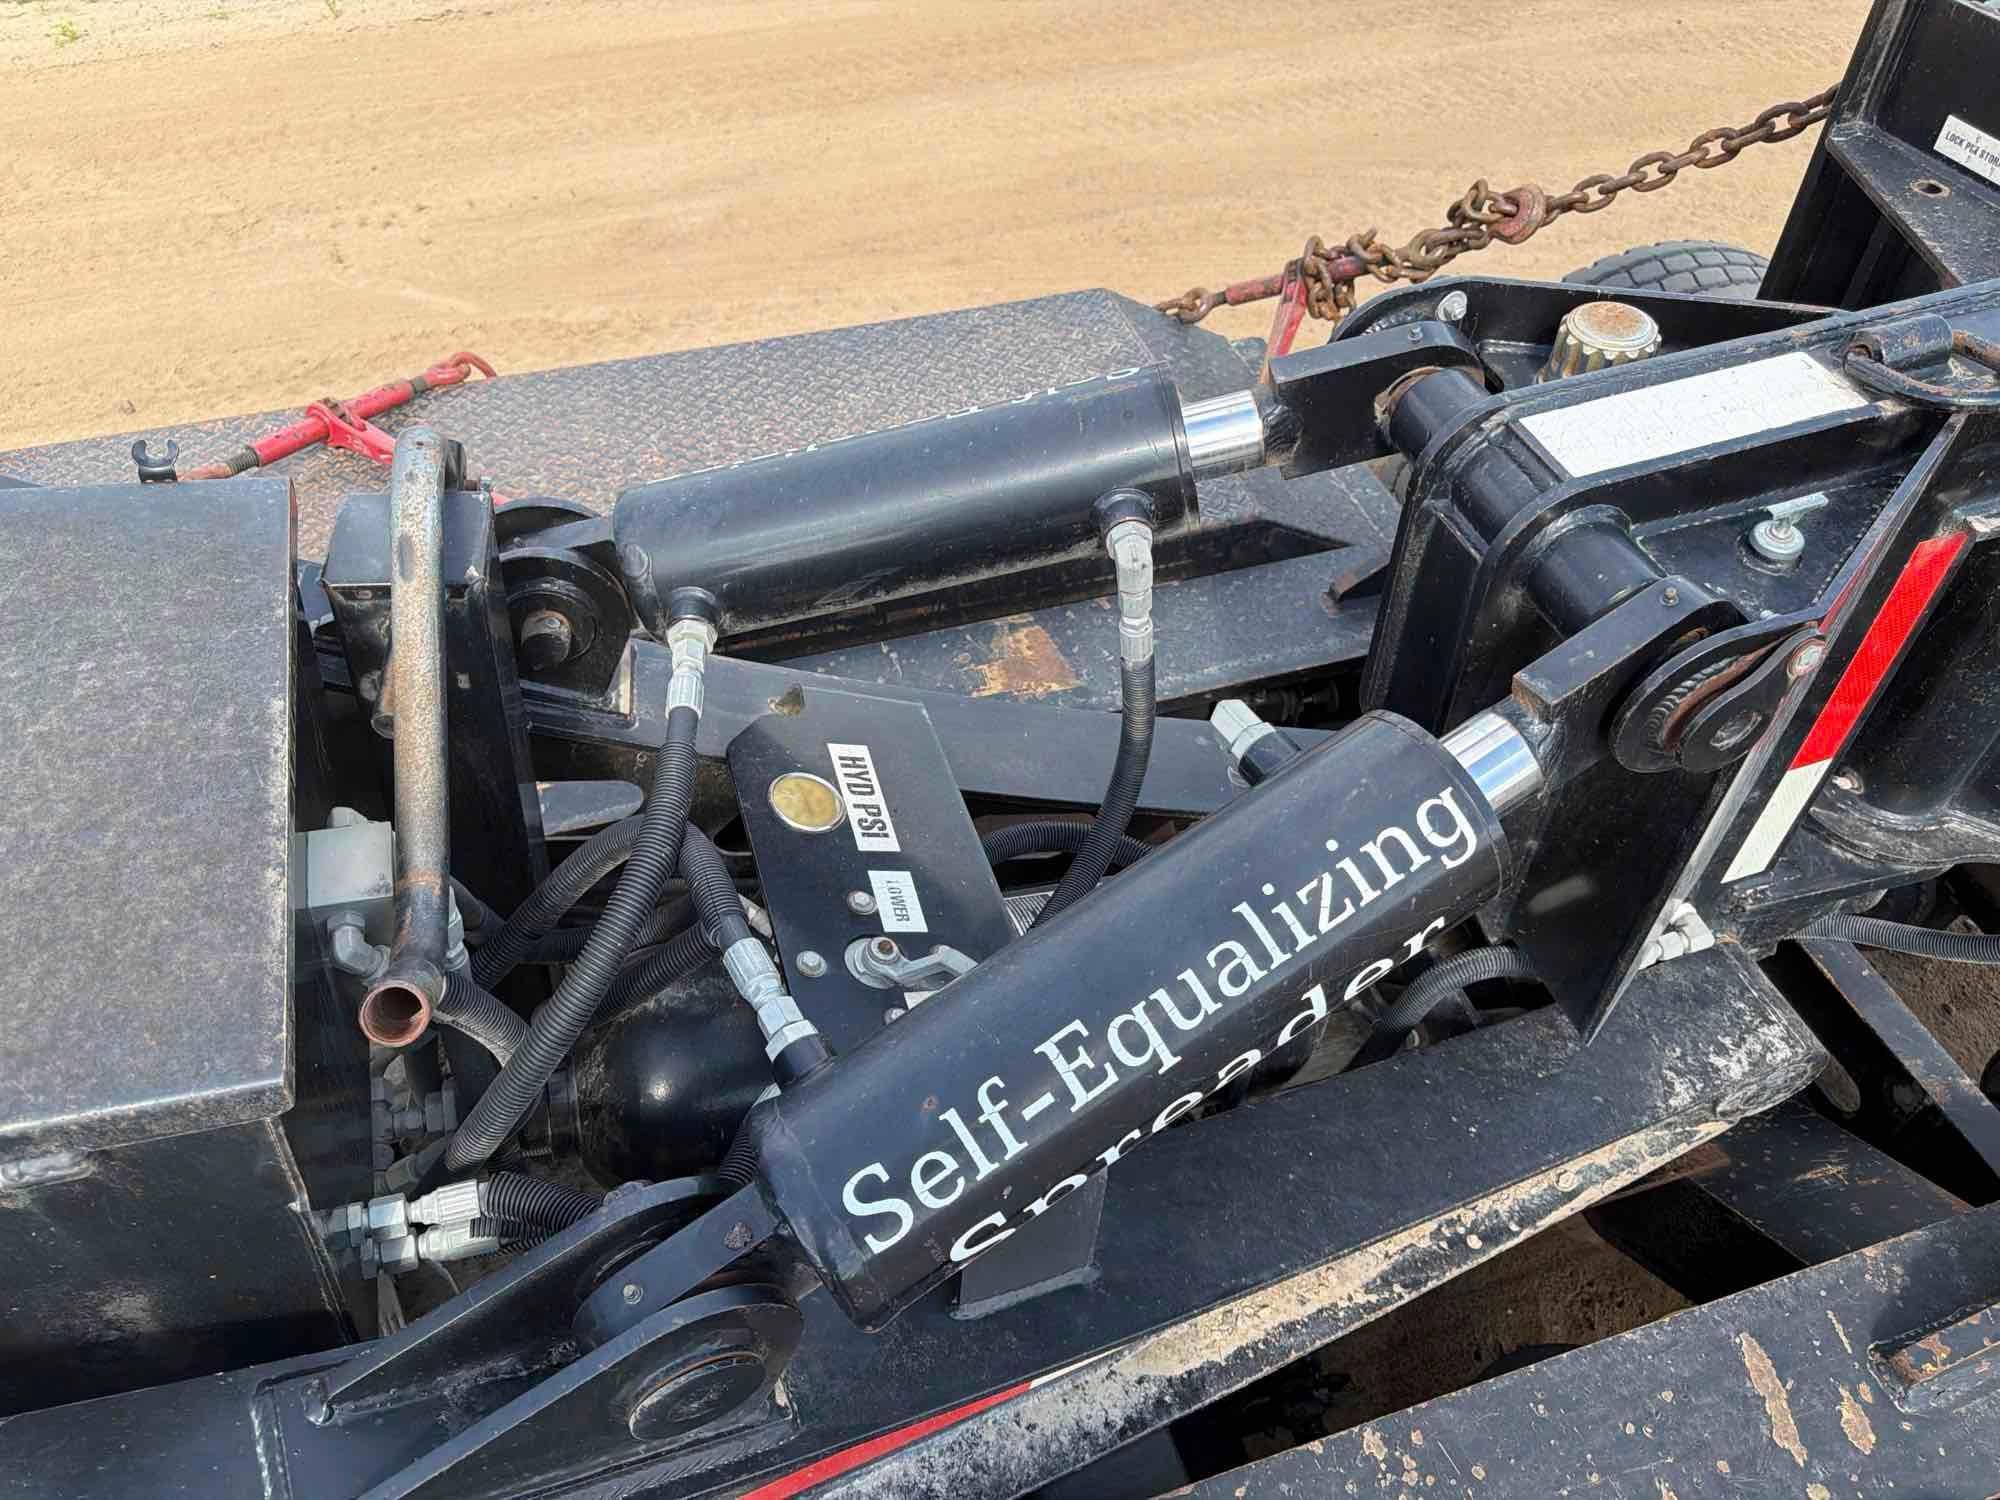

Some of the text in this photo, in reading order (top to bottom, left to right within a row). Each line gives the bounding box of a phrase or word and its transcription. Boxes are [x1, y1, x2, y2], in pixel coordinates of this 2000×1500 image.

[1946, 131, 1965, 146] LOCK
[838, 755, 889, 839] HYD PSI
[842, 786, 1477, 1254] Self-Equalizing
